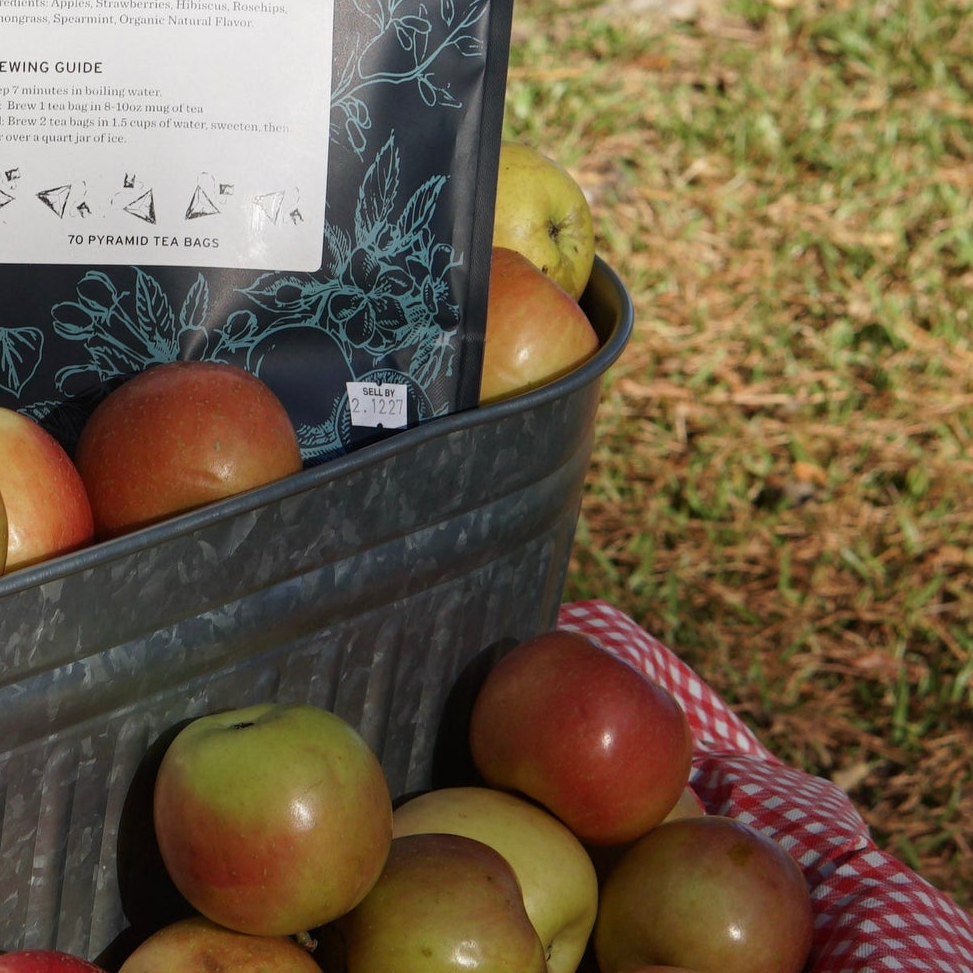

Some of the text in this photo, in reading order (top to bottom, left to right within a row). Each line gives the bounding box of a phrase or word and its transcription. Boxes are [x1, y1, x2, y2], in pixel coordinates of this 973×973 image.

[176, 0, 230, 12] Hibiscus,
[53, 13, 117, 26] Spearmint,
[119, 14, 165, 27] Organic
[168, 15, 212, 27] Natural
[215, 16, 255, 28] Flavor.
[55, 61, 103, 74] GUIDE
[13, 86, 19, 96] 7
[21, 85, 69, 96] minutes
[71, 86, 82, 96] in
[85, 86, 125, 98] boiling
[127, 87, 163, 98] water.
[7, 101, 37, 112] Brew
[40, 101, 45, 111] 1
[48, 101, 66, 112] tea
[68, 101, 88, 114] bag
[90, 101, 102, 112] in
[104, 102, 143, 113] 8-10oz
[145, 106, 170, 115] mug
[171, 102, 185, 114] of
[186, 104, 204, 114] tea
[8, 116, 37, 127] Brew
[39, 116, 47, 127] 2
[49, 117, 67, 127] tea
[69, 117, 95, 129] bags
[97, 117, 109, 128] in
[112, 117, 128, 129] 1.5
[129, 119, 157, 130] cups
[158, 118, 172, 129] of
[173, 120, 209, 132] water,
[5, 133, 30, 143] over
[33, 134, 40, 143] a
[41, 133, 73, 145] quart
[74, 132, 92, 145] jar
[93, 132, 107, 144] of
[107, 132, 128, 144] ice.
[68, 234, 220, 249] 70 PYRAMID TEA BAGS
[362, 387, 395, 398] SELL BY
